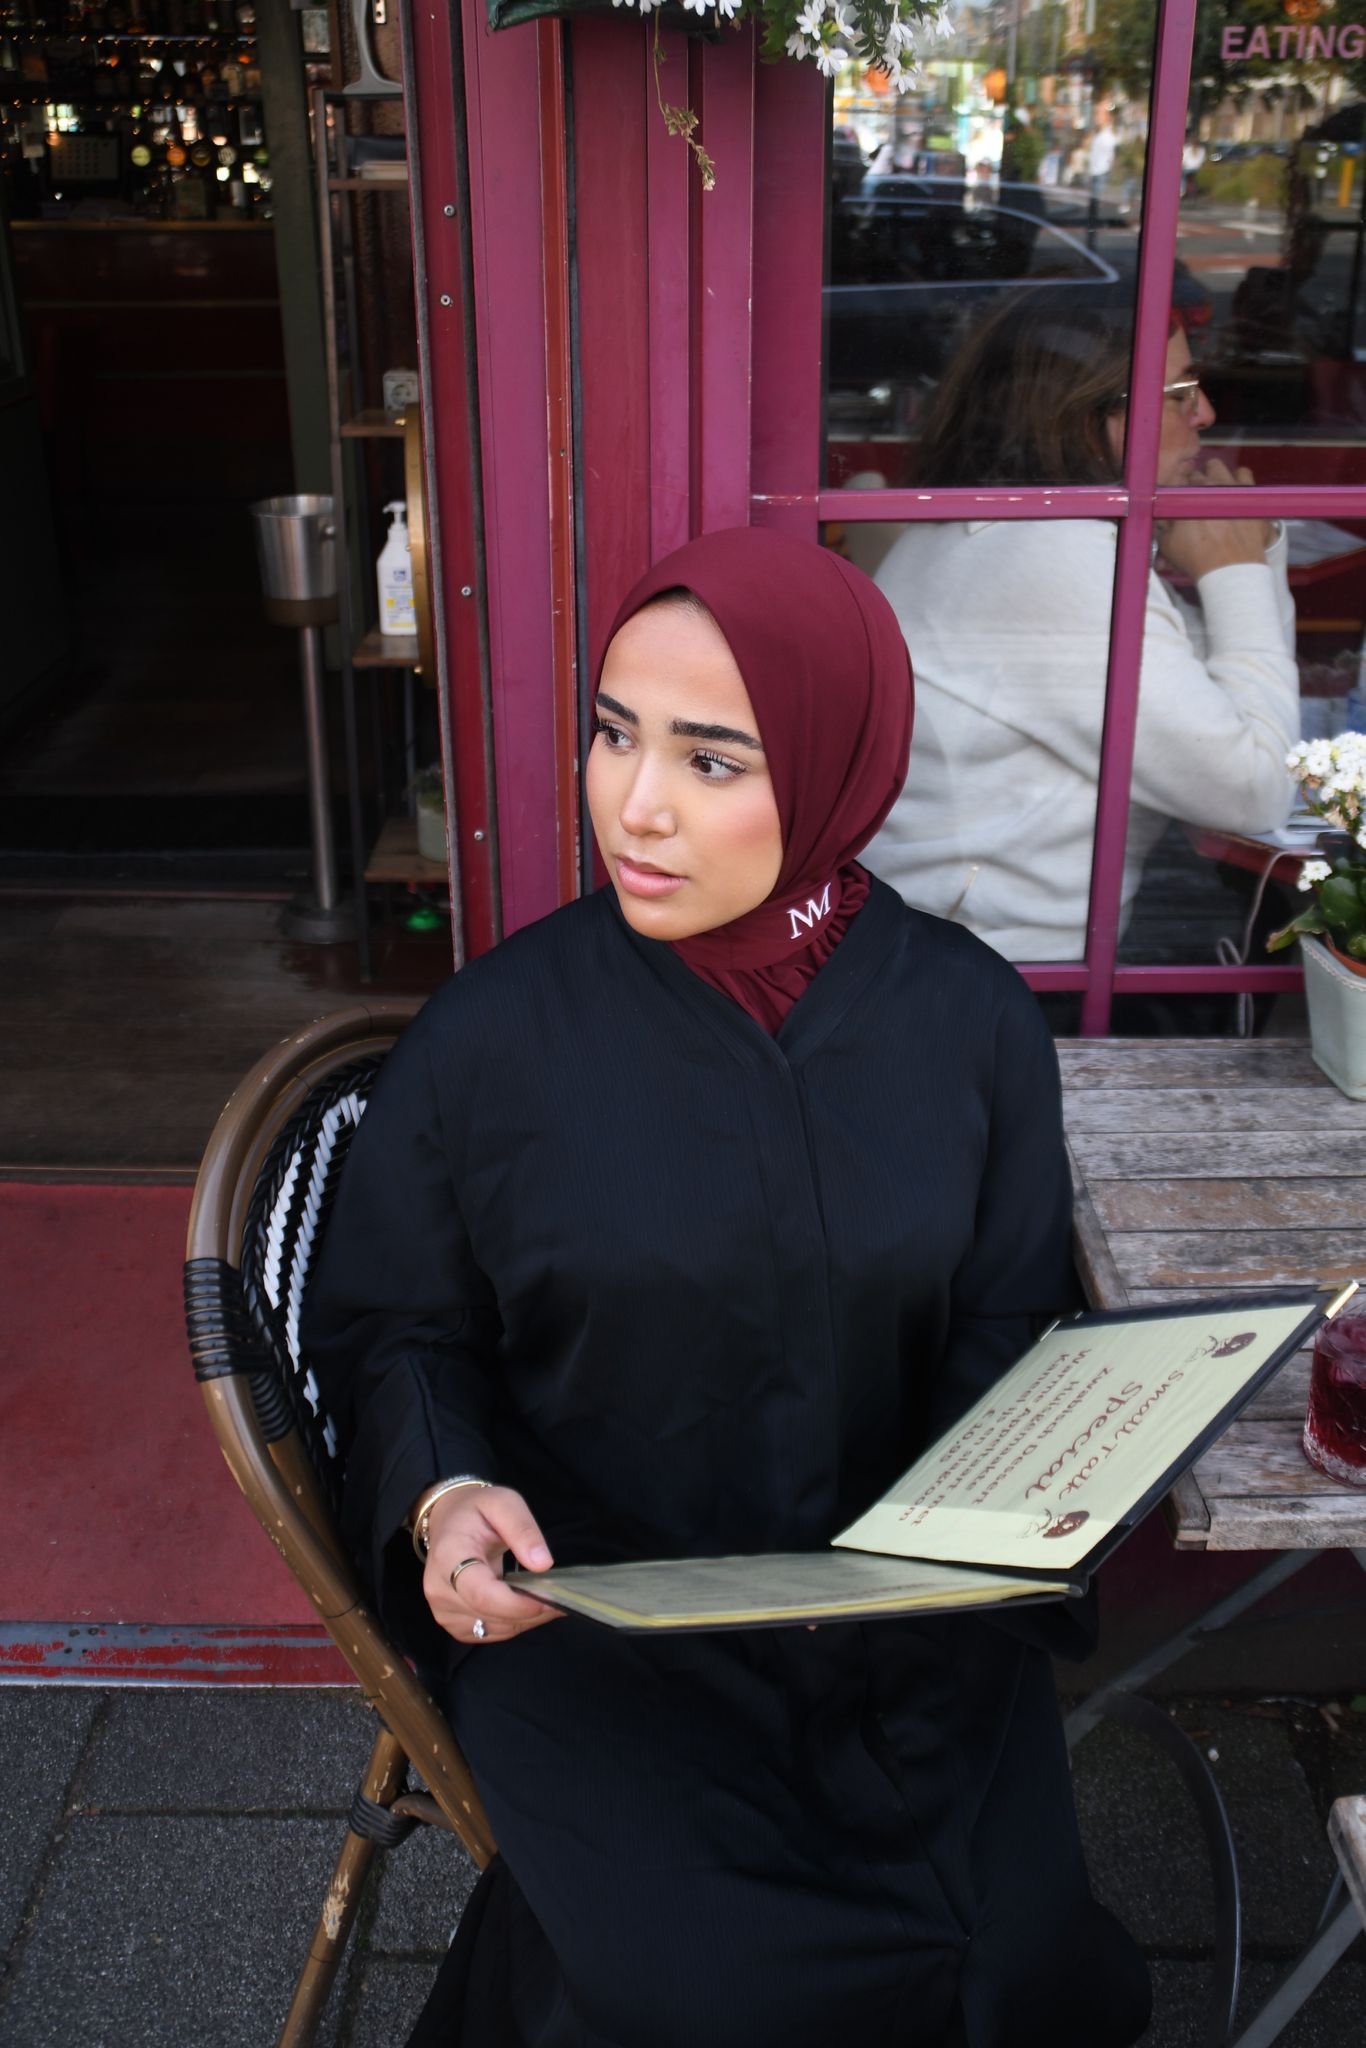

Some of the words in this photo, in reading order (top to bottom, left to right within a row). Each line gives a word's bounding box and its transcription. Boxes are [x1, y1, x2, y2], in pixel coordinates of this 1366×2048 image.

[1220, 24, 1366, 60] EATING
[1015, 1353, 1069, 1403] Kaneel
[1033, 1348, 1091, 1403] Warme
[1037, 1366, 1111, 1439] Zwabisch
[1114, 1370, 1184, 1439] Small
[965, 1380, 1079, 1490] Huisgemaakte
[973, 1426, 994, 1445] en
[993, 1405, 1017, 1425] ijs
[1024, 1381, 1142, 1498] Special
[947, 1407, 1031, 1489] Appeltaart
[971, 1443, 1038, 1504] Dessert
[1058, 1444, 1117, 1499] Talk
[898, 1450, 972, 1521] slagroom
[911, 1493, 945, 1525] met
